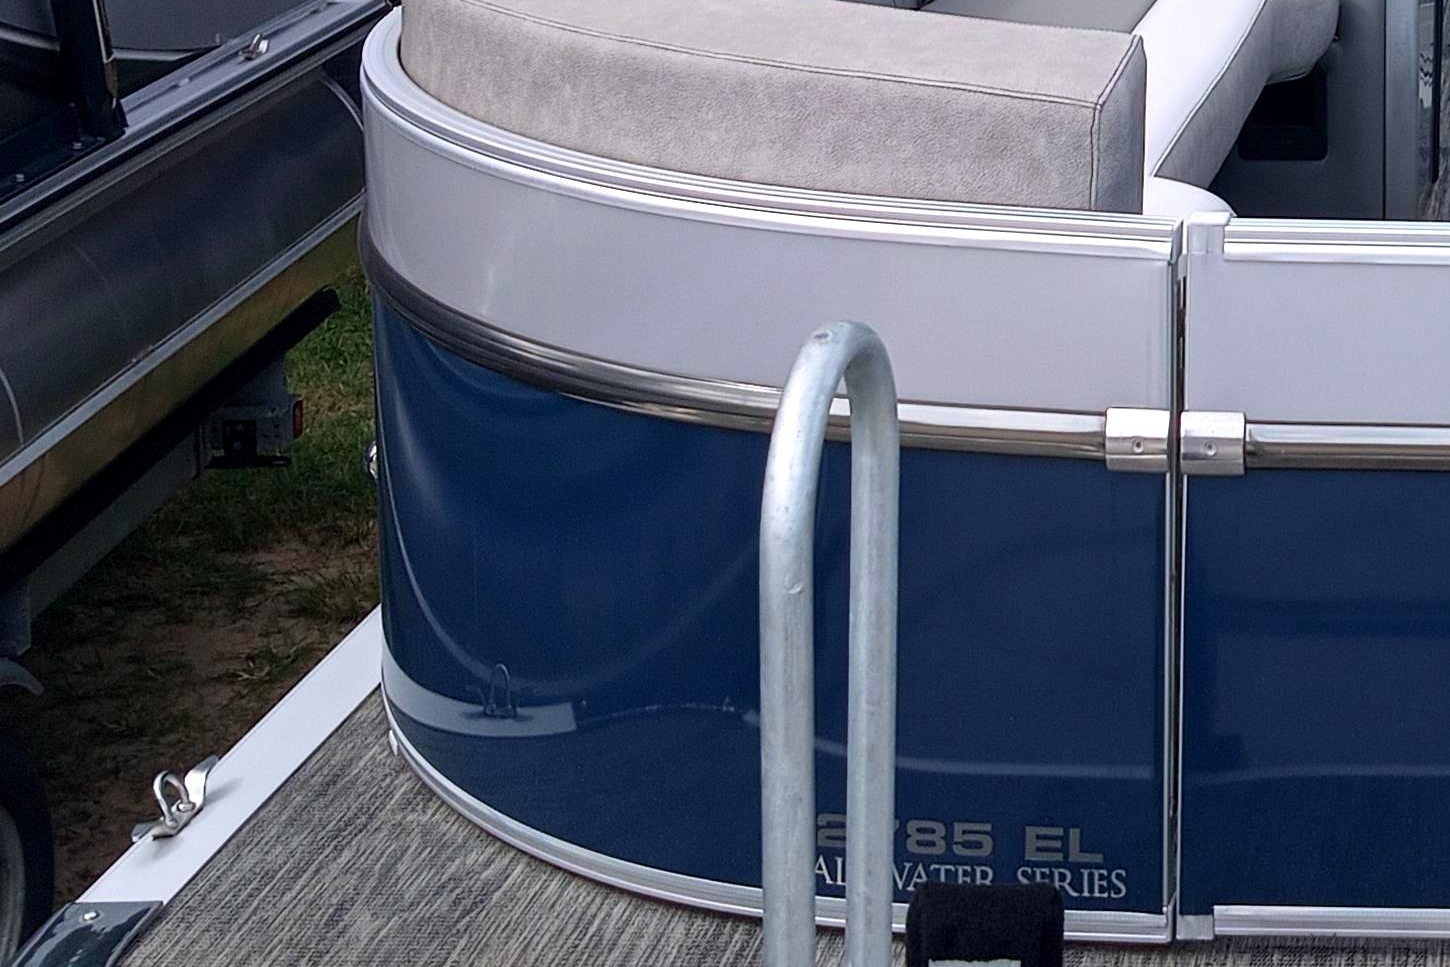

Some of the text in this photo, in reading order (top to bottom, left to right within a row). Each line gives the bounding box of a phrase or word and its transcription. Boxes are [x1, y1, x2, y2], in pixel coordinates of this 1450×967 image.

[816, 813, 1104, 863] 285 EL
[1016, 866, 1128, 899] SERIES
